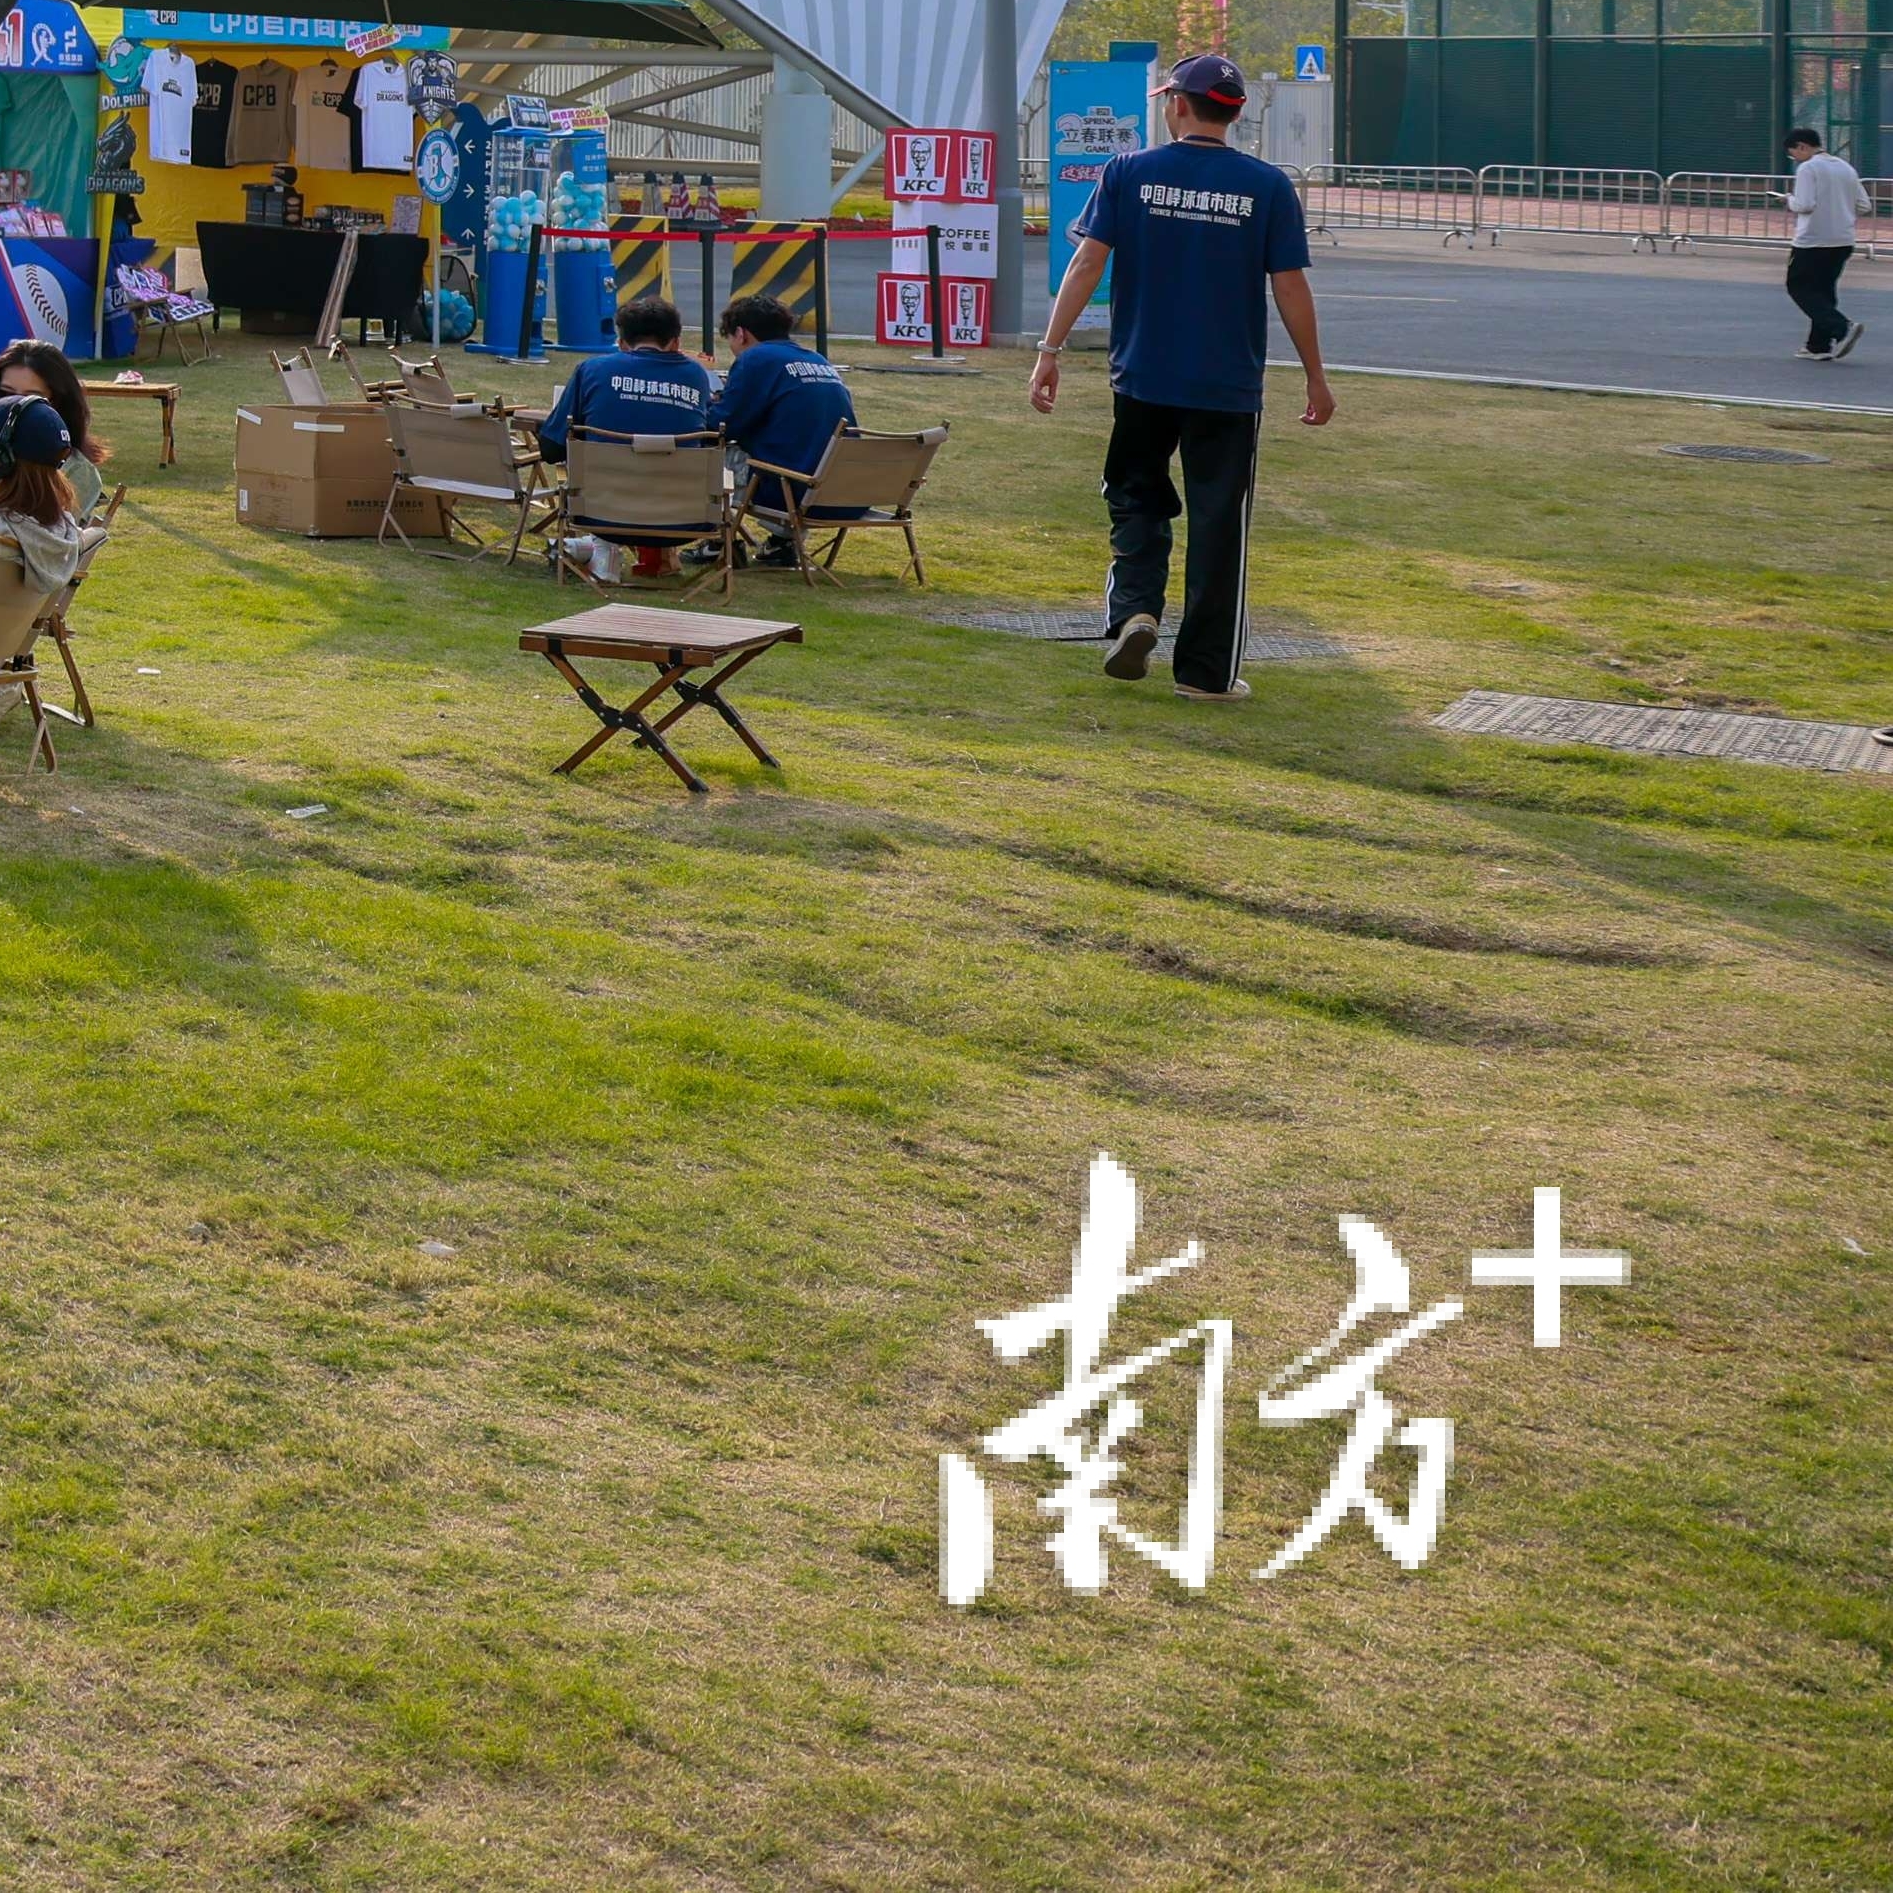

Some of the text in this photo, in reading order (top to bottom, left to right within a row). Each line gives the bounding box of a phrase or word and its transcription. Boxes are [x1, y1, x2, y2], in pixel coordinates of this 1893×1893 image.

[243, 84, 276, 106] CPB
[376, 93, 404, 102] DRAGONS
[423, 86, 456, 100] KNIGHTS
[1082, 117, 1115, 126] SPRING
[1063, 127, 1134, 144] 立春联赛
[1085, 144, 1111, 154] GAME
[86, 176, 145, 193] DRAGONS
[902, 179, 938, 192] KFC
[965, 181, 985, 195] KFC
[1139, 184, 1254, 217] 中国棒球城市联赛
[893, 324, 927, 338] KFC
[954, 327, 978, 341] KFC
